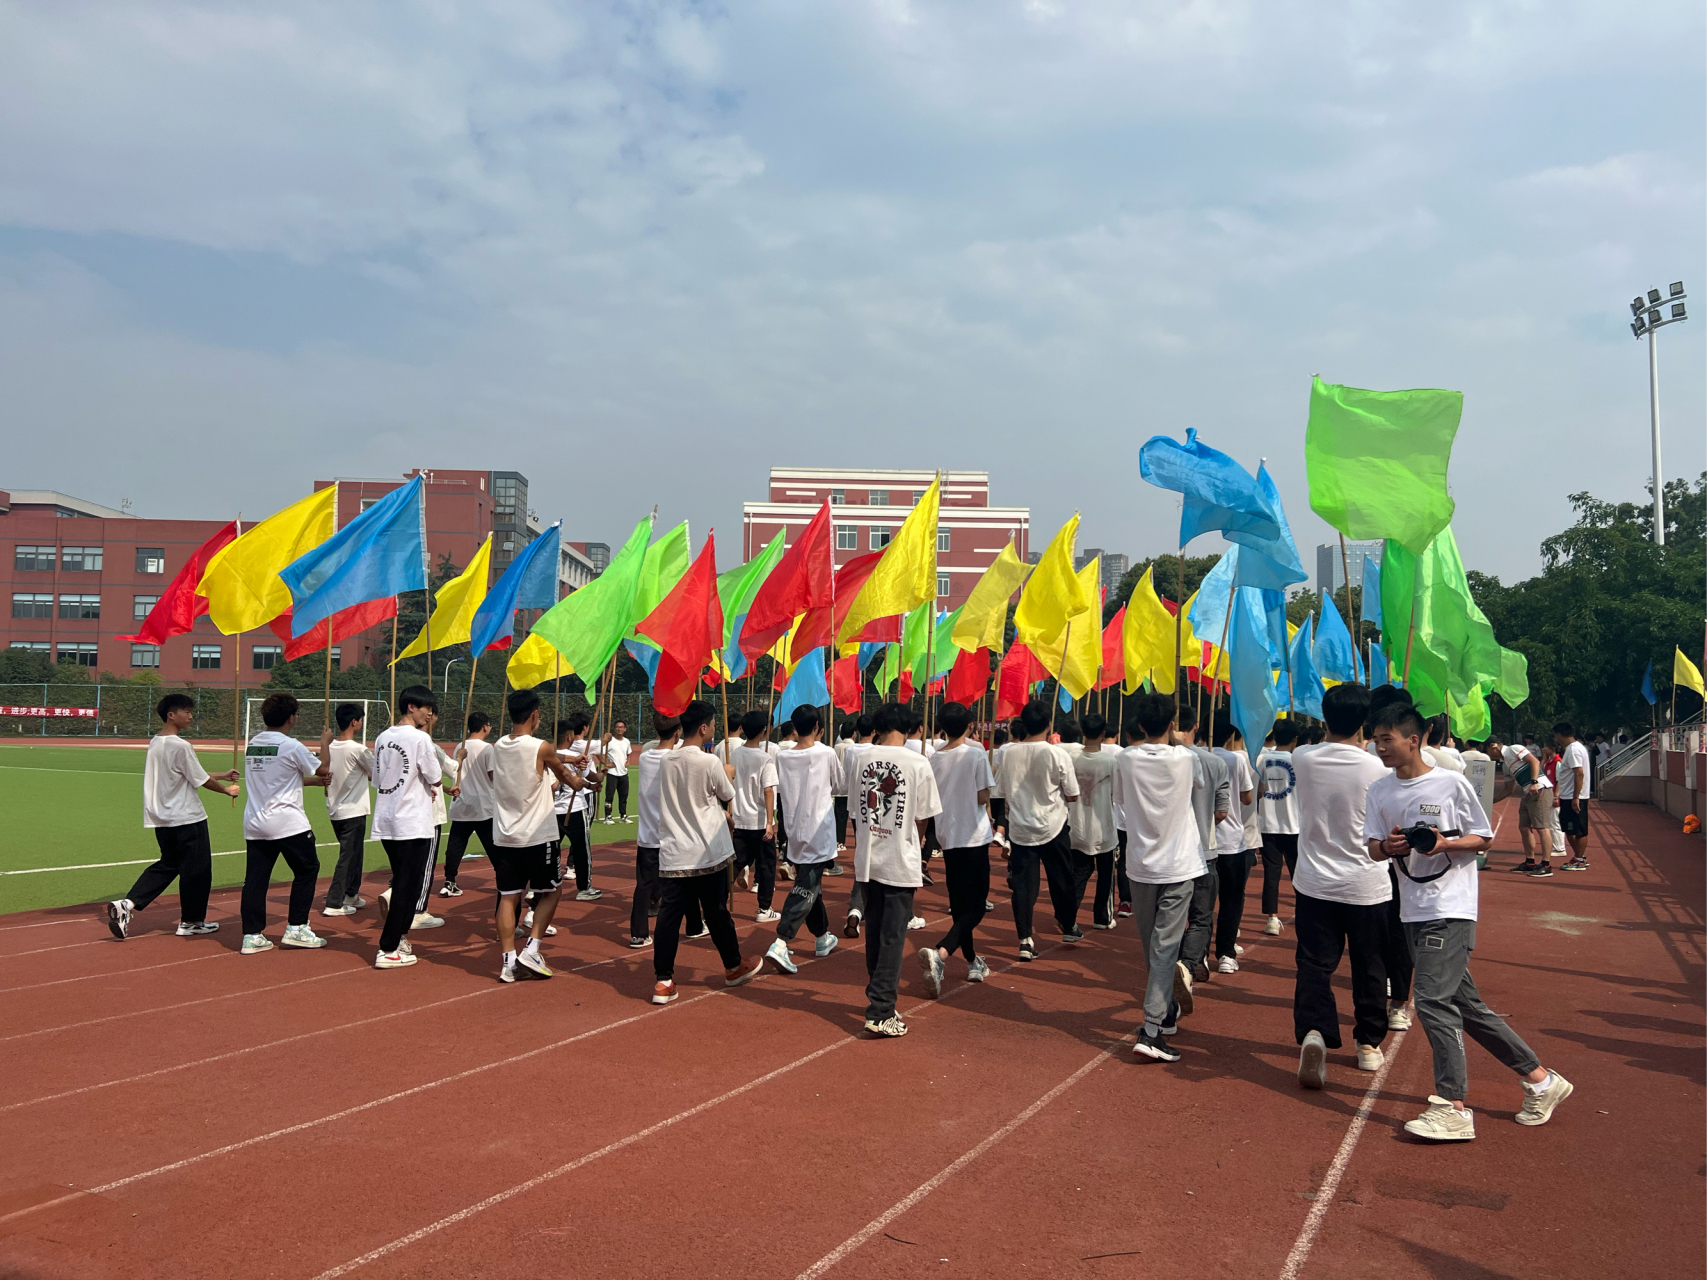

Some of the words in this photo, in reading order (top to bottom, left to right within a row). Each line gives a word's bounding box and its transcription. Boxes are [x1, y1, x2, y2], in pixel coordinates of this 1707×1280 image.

[860, 760, 906, 786] YOURSELF
[894, 791, 906, 829] FIRST
[1420, 804, 1441, 814] 2000
